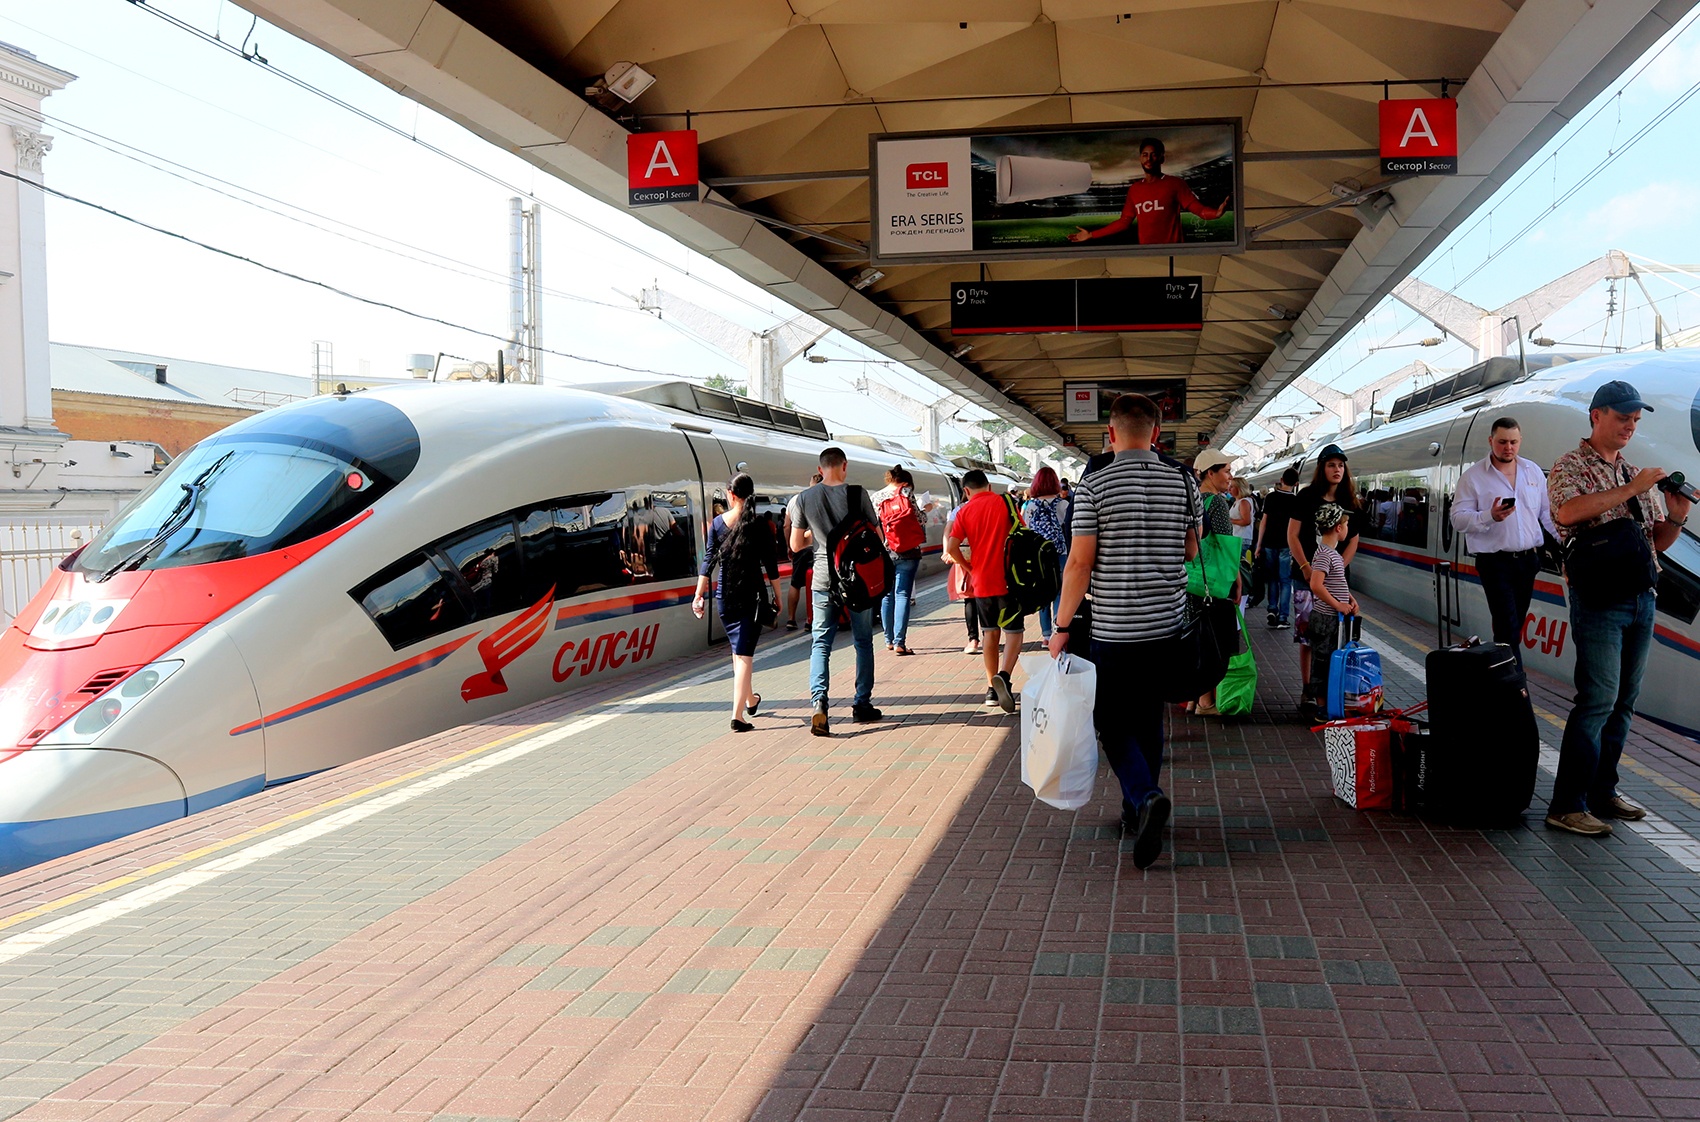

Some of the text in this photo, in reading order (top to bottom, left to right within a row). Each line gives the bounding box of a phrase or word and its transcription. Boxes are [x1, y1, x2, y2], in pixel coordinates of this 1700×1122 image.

[1386, 161, 1452, 172] Сектор Sector
[911, 170, 943, 181] TCL
[633, 191, 692, 201] Сектор Sector
[1135, 199, 1165, 215] TCL
[891, 212, 964, 228] ERA SERIES
[925, 226, 965, 235] ЛЕГЕНДОЙ
[956, 288, 989, 305] 9 Путь
[1165, 283, 1199, 300] Путь 7
[1066, 435, 1072, 443] 9
[1519, 612, 1568, 658] САН
[552, 623, 660, 683] САПСАН
[1417, 750, 1427, 791] Лабиринт
